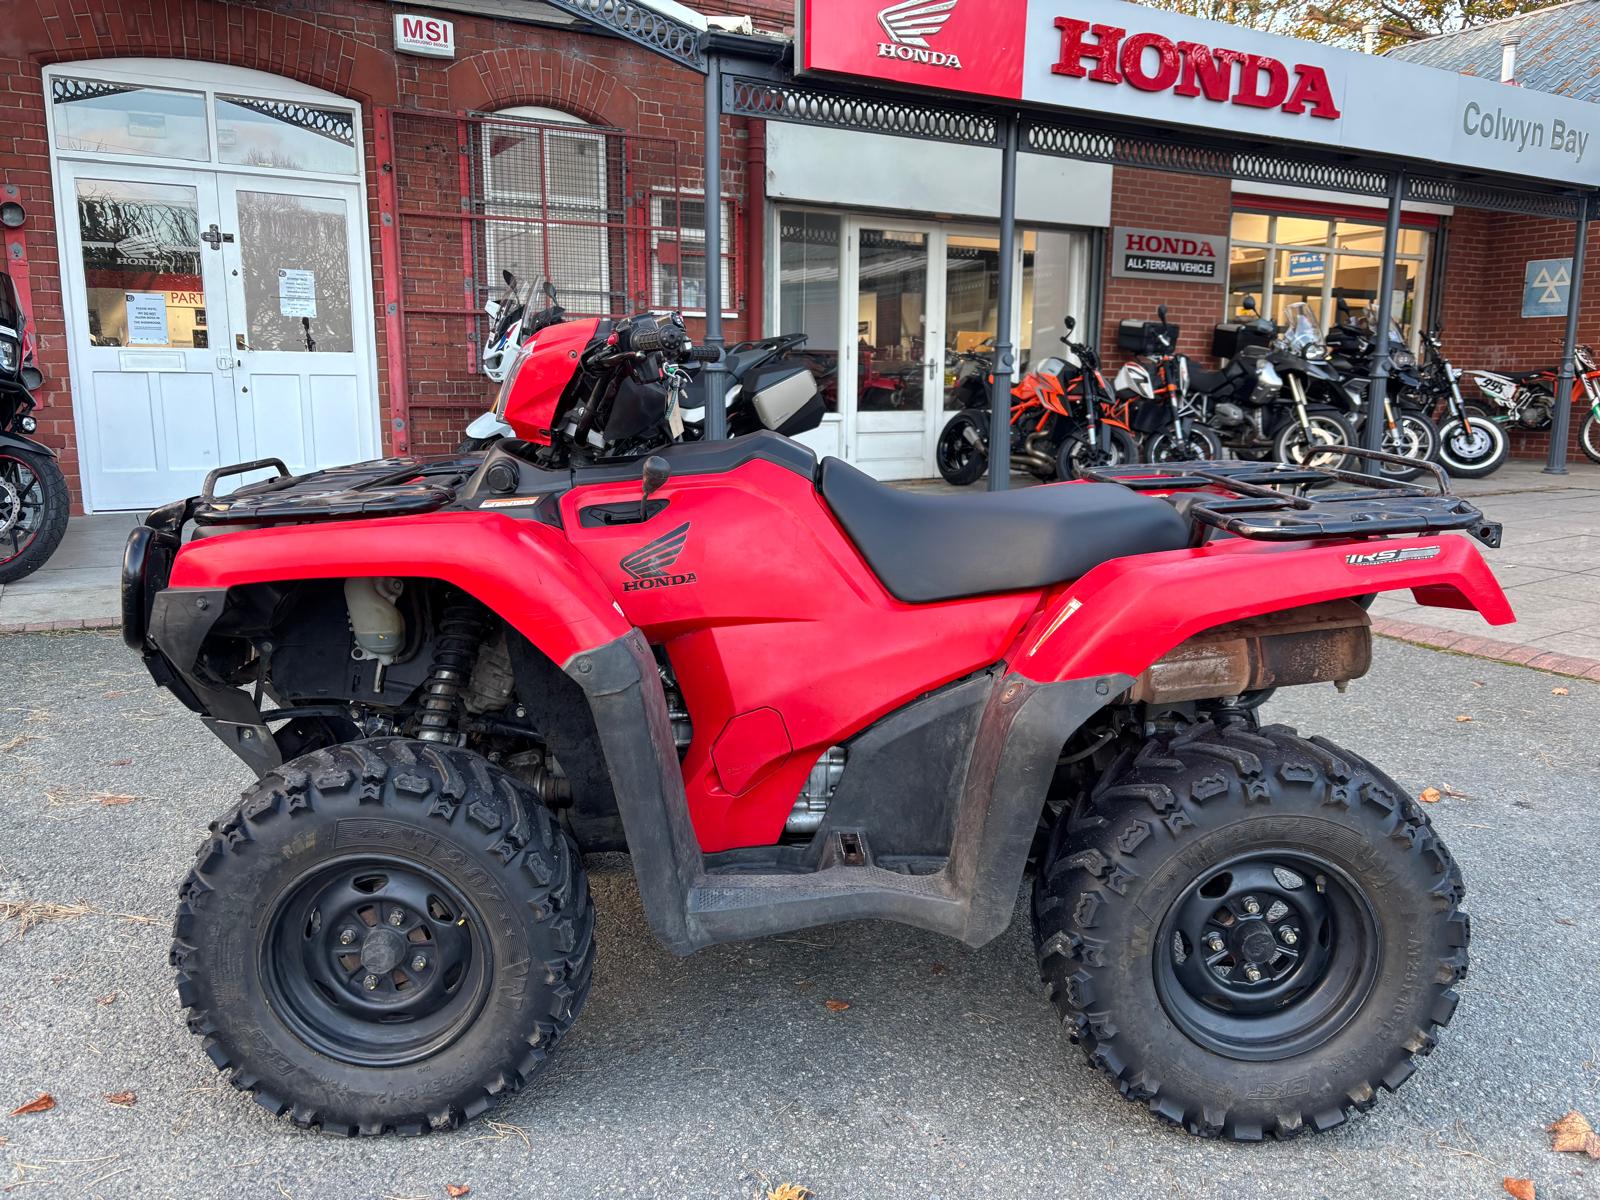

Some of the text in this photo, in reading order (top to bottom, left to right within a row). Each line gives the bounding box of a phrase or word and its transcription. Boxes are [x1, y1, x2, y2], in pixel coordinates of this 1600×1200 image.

[403, 18, 448, 43] MSI
[877, 42, 962, 70] HONDA
[1051, 16, 1341, 120] HONDA
[1463, 101, 1590, 164] Colwyn Bay
[1125, 233, 1217, 257] HONDA
[116, 257, 172, 268] HONDA
[1127, 258, 1213, 274] ALL-TERRAIN VEHICLE
[1480, 378, 1507, 394] 995
[622, 573, 697, 592] HONDA
